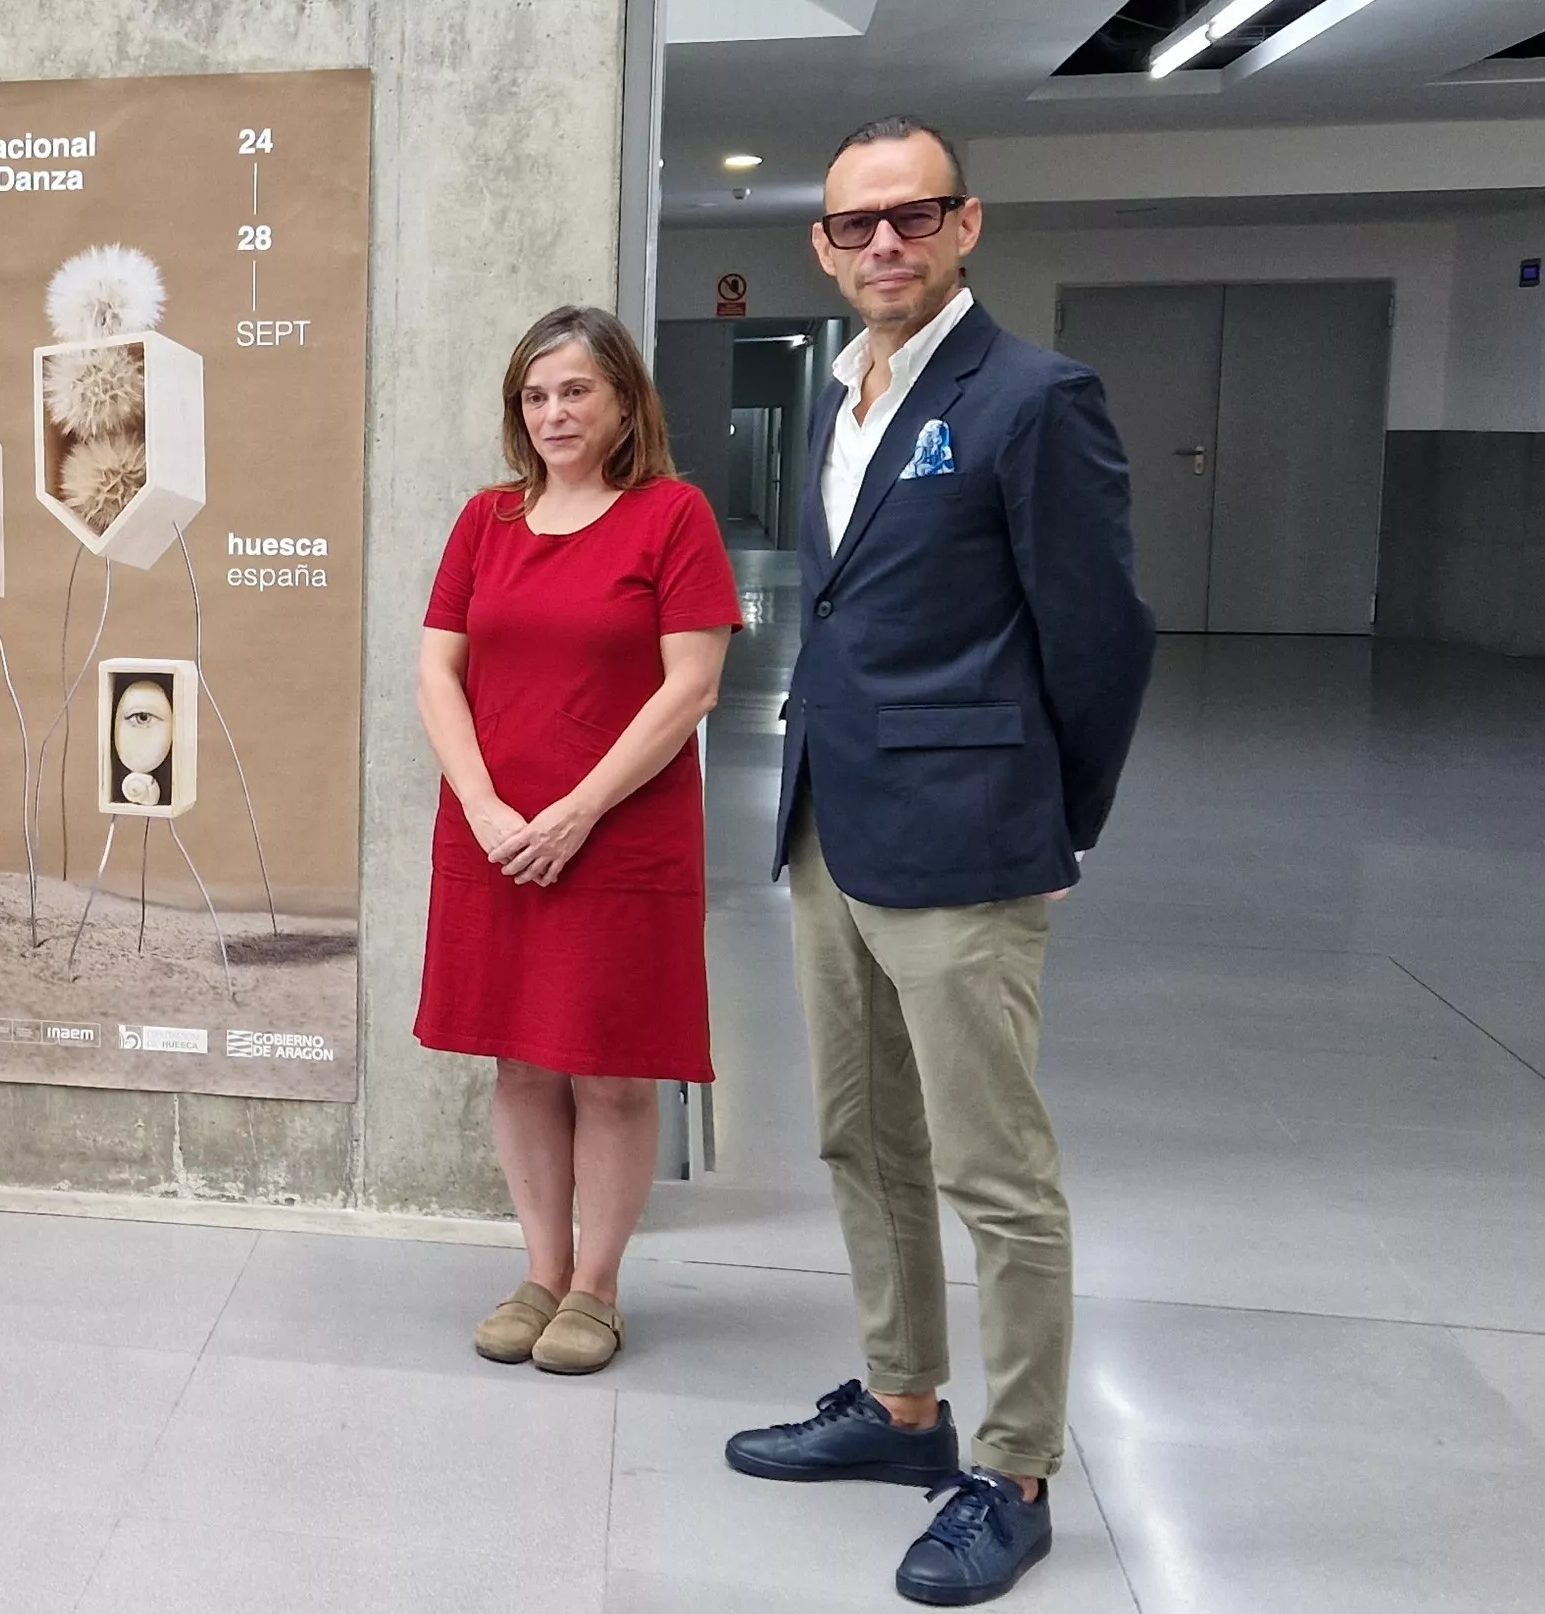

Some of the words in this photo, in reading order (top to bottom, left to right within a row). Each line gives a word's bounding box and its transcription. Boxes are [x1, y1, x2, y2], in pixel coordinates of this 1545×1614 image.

[238, 128, 274, 154] 24
[237, 225, 273, 251] 28
[236, 320, 311, 347] SEPT
[228, 532, 328, 556] huesca
[227, 563, 328, 592] españa
[46, 1026, 95, 1041] inaem
[161, 1040, 198, 1050] HUESCA
[253, 1032, 324, 1048] GOBIERNO
[252, 1044, 272, 1058] DE
